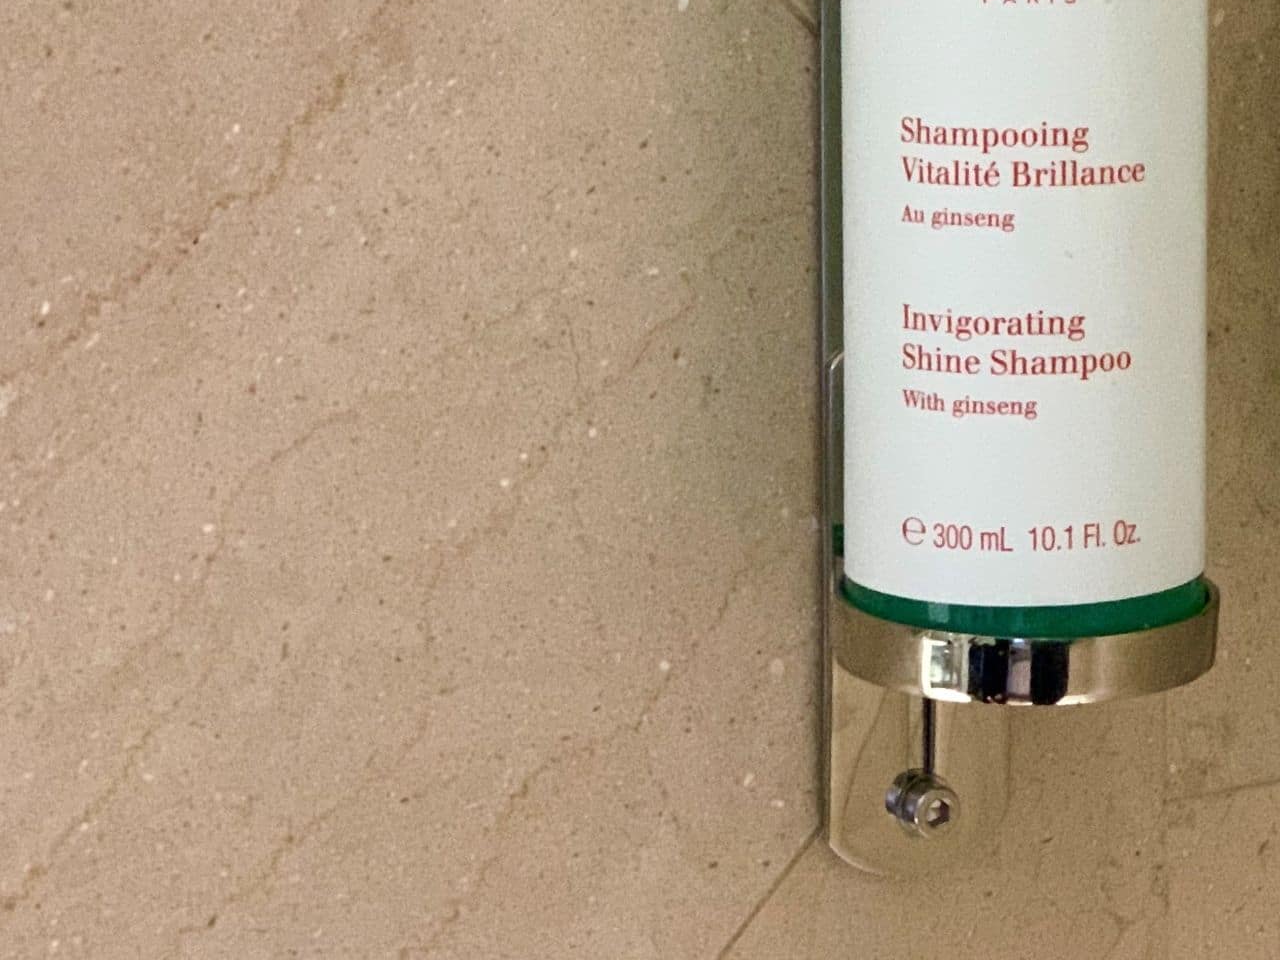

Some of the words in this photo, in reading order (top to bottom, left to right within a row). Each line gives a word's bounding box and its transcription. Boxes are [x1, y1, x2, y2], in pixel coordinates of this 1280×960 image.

[901, 116, 1090, 155] Shampooing
[901, 156, 1001, 188] Vitalité
[1012, 160, 1146, 188] Brillance
[901, 205, 925, 224] Au
[931, 208, 1015, 233] ginseng
[902, 304, 1086, 341] Invigorating
[902, 342, 981, 375] Shine
[990, 349, 1132, 381] Shampoo
[902, 389, 946, 413] With
[952, 396, 1038, 420] ginseng
[933, 523, 973, 551] 300
[980, 527, 1014, 552] mL
[1028, 525, 1074, 552] 10.1
[1113, 520, 1142, 546] Oz.
